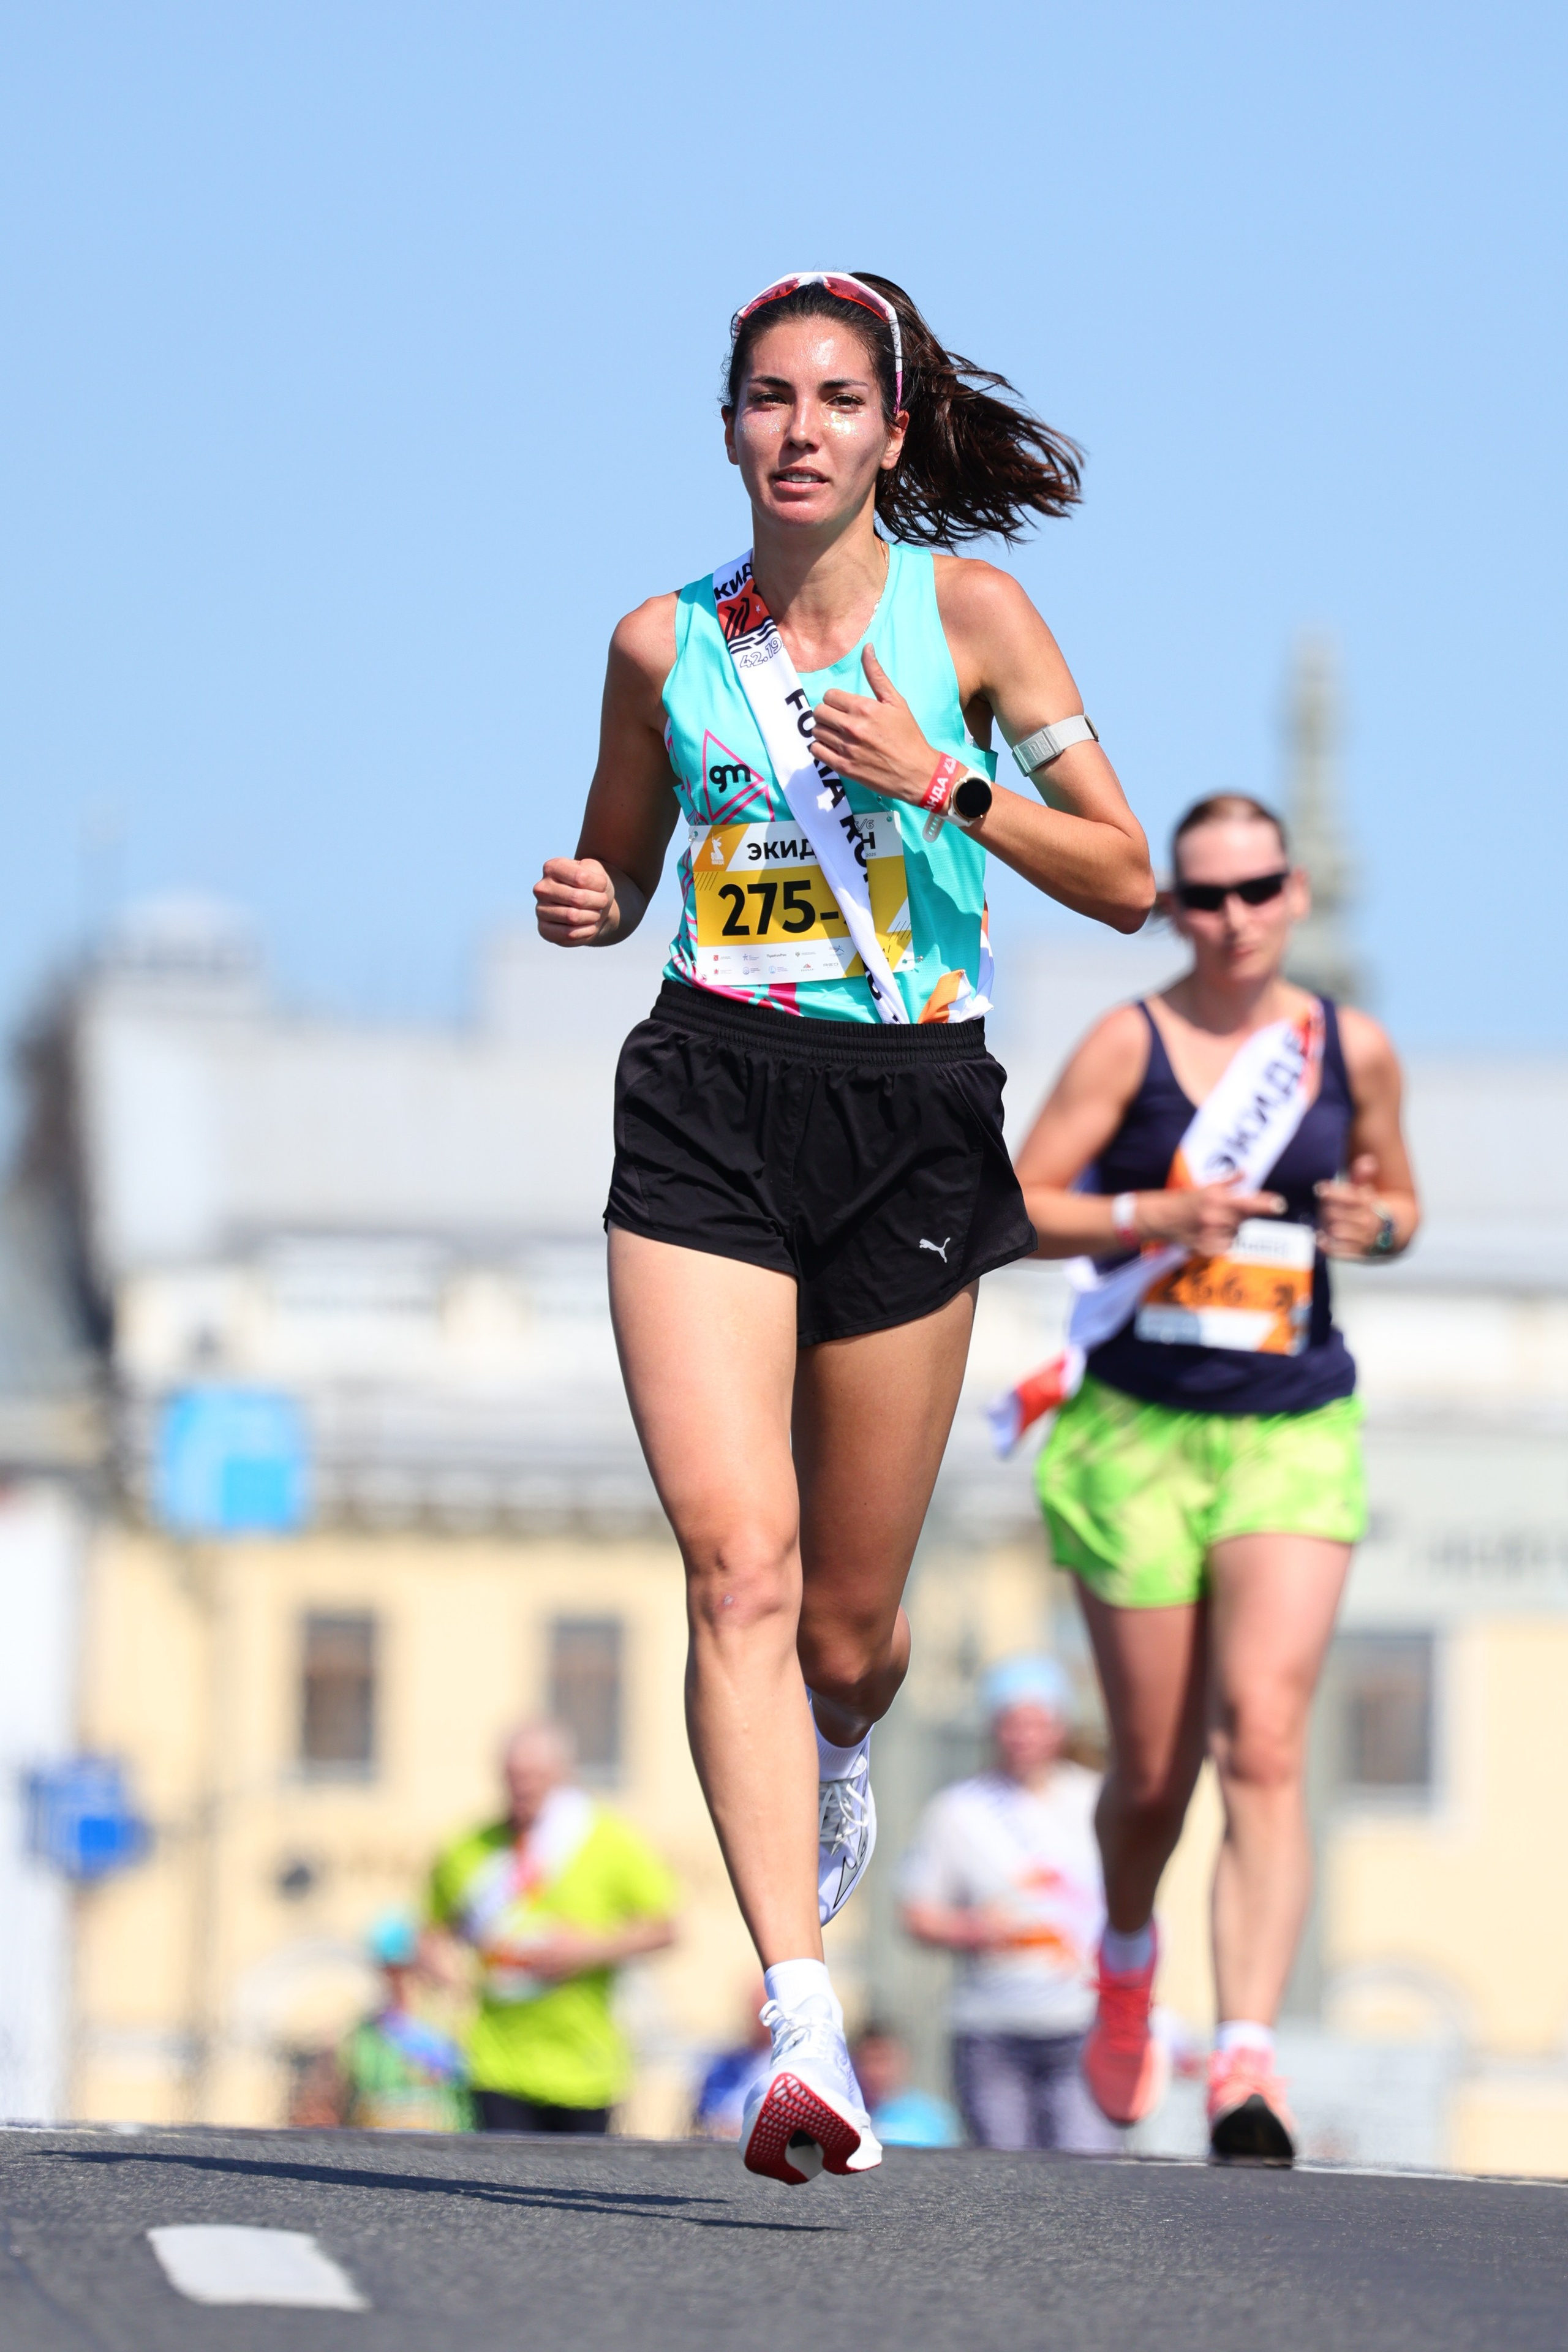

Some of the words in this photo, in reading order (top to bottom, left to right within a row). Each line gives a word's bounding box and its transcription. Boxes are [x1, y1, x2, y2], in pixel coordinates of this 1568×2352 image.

[739, 637, 786, 668] 42.19
[923, 777, 949, 812] АНДА
[746, 831, 876, 861] ЭКИДН
[718, 880, 848, 937] 275-
